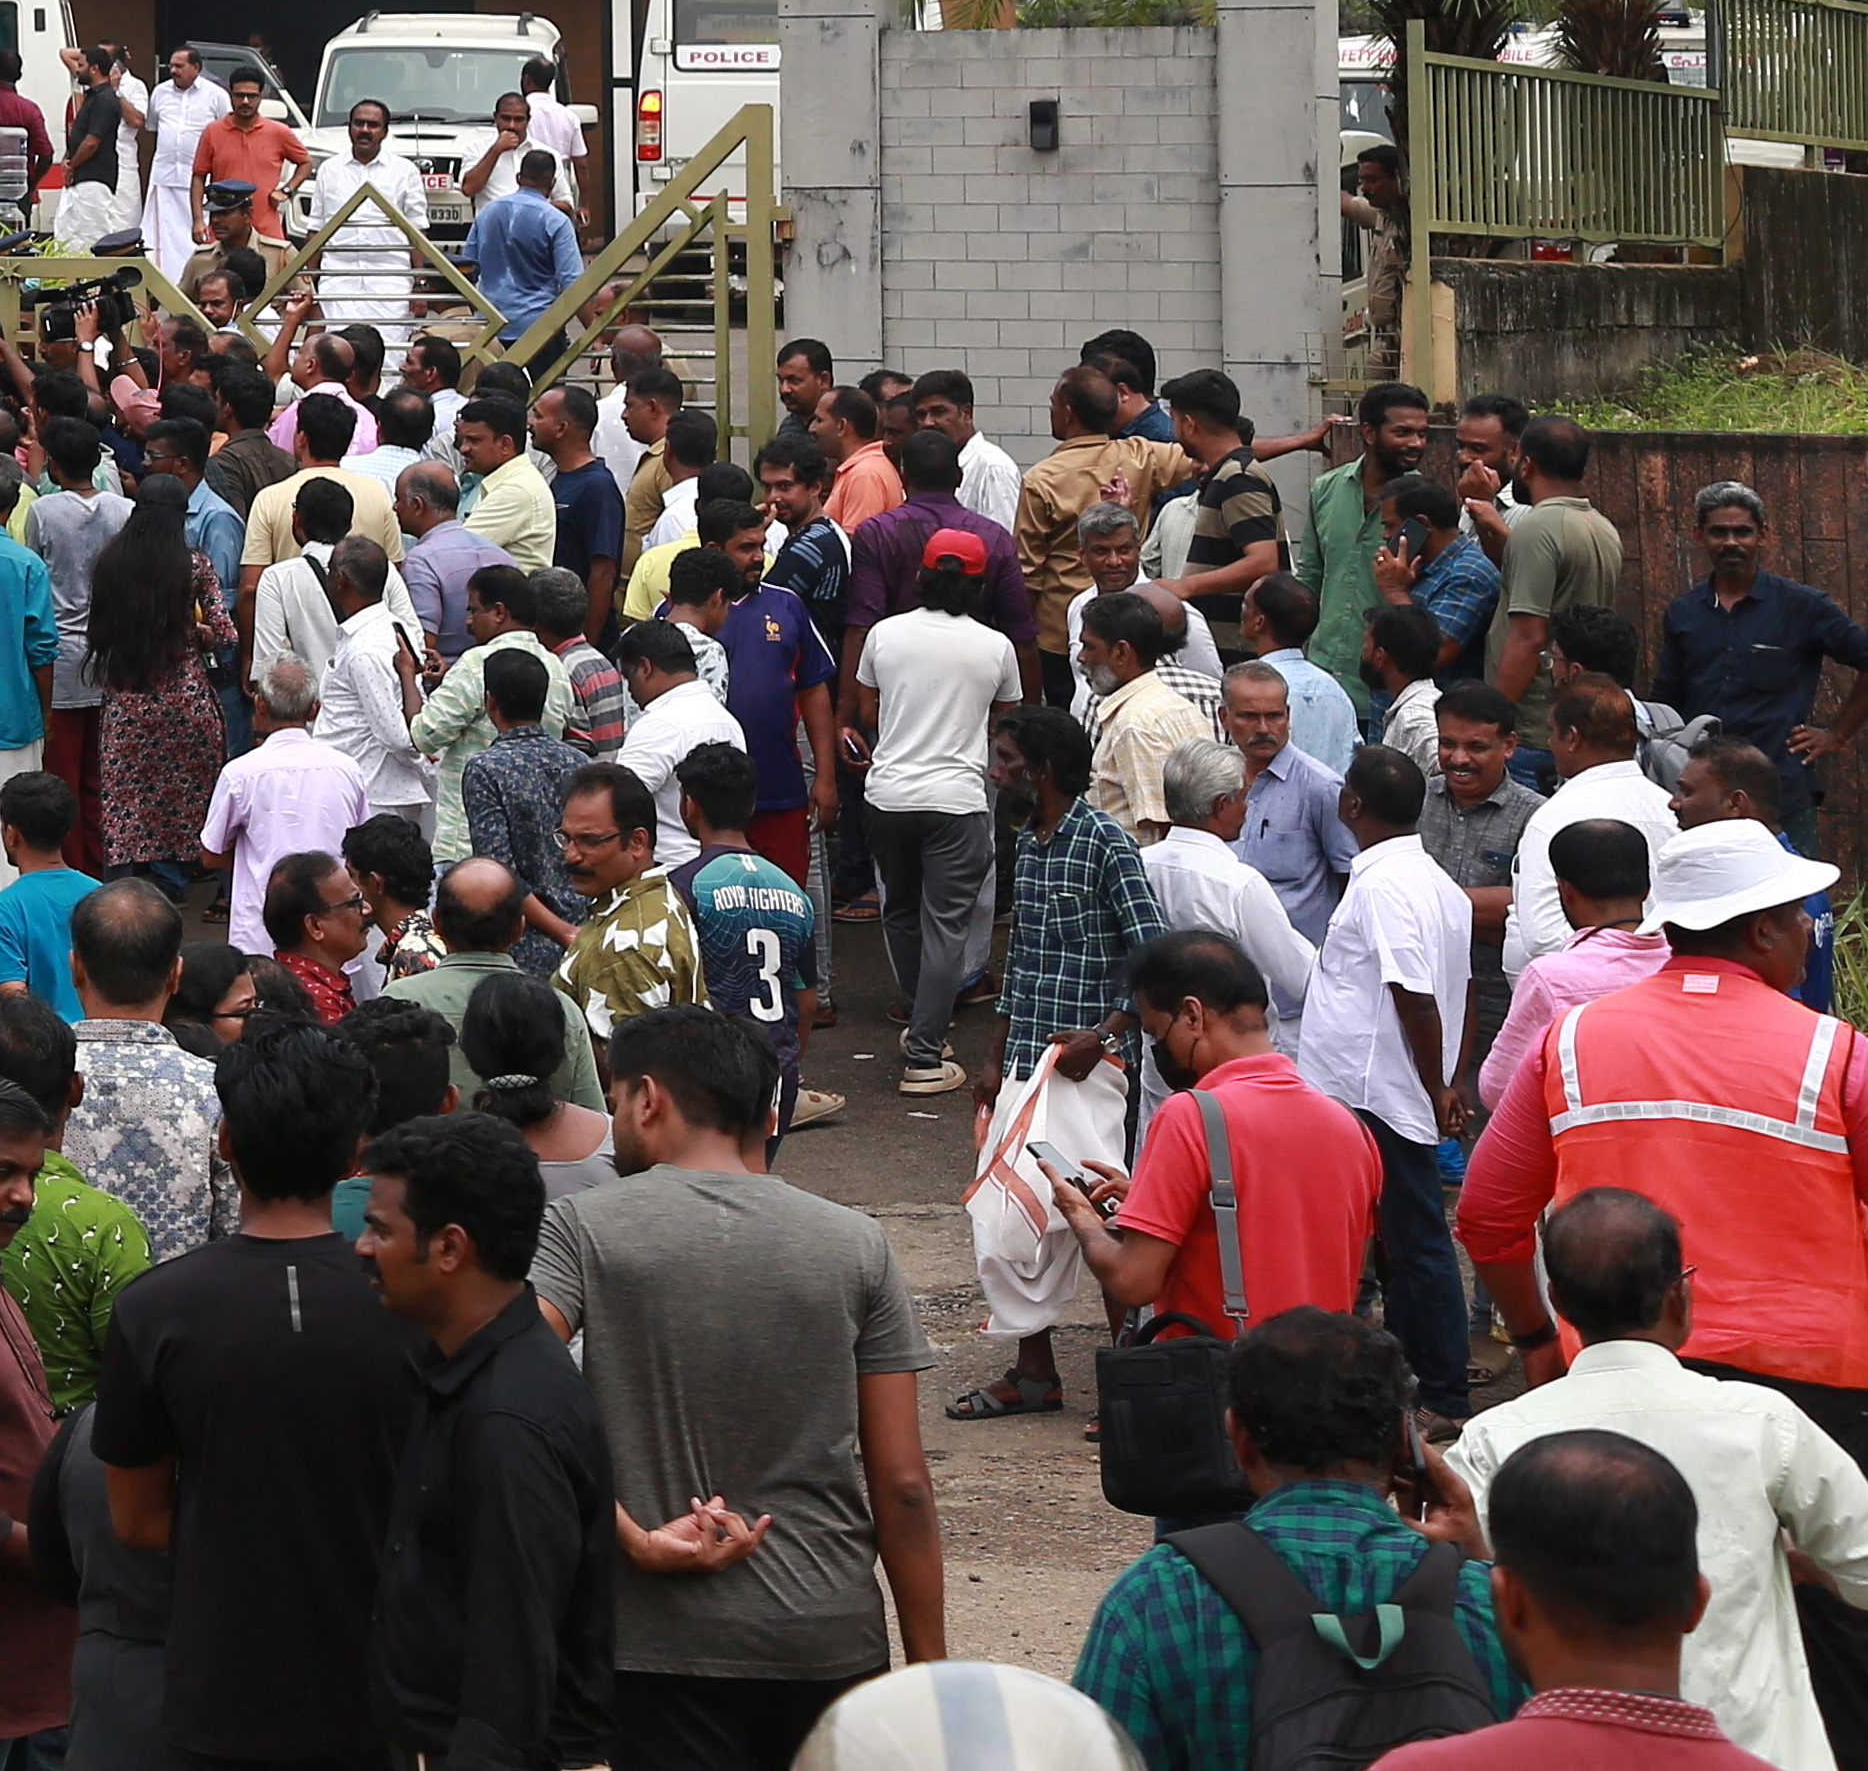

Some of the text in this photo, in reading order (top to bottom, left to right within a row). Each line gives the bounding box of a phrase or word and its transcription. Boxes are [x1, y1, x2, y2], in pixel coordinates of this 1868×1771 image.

[689, 51, 769, 63] POLICE
[1338, 48, 1373, 62] FETY
[1496, 48, 1533, 62] BILE
[422, 176, 447, 188] ICE
[749, 887, 805, 919] FIGHTERS
[747, 927, 785, 1022] 3
